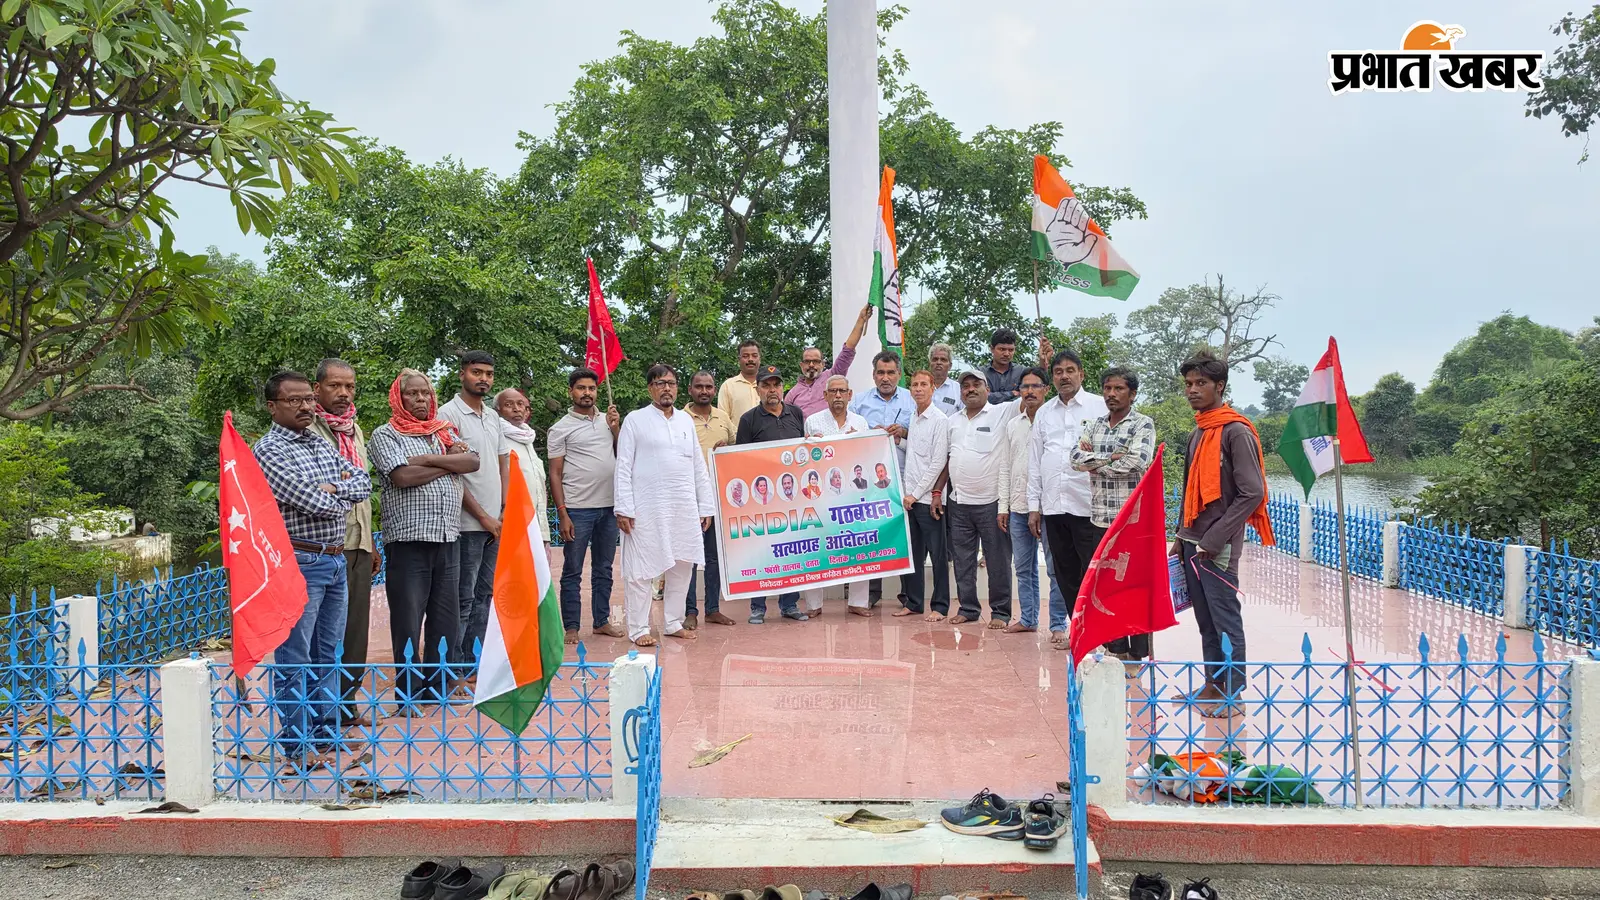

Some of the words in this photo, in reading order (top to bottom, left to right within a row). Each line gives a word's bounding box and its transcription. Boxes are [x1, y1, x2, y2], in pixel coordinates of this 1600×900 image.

[729, 507, 823, 539] INDIA
[829, 497, 892, 525] गठबंधन
[771, 537, 820, 558] सत्याग्रह
[825, 529, 879, 550] आंदोलन
